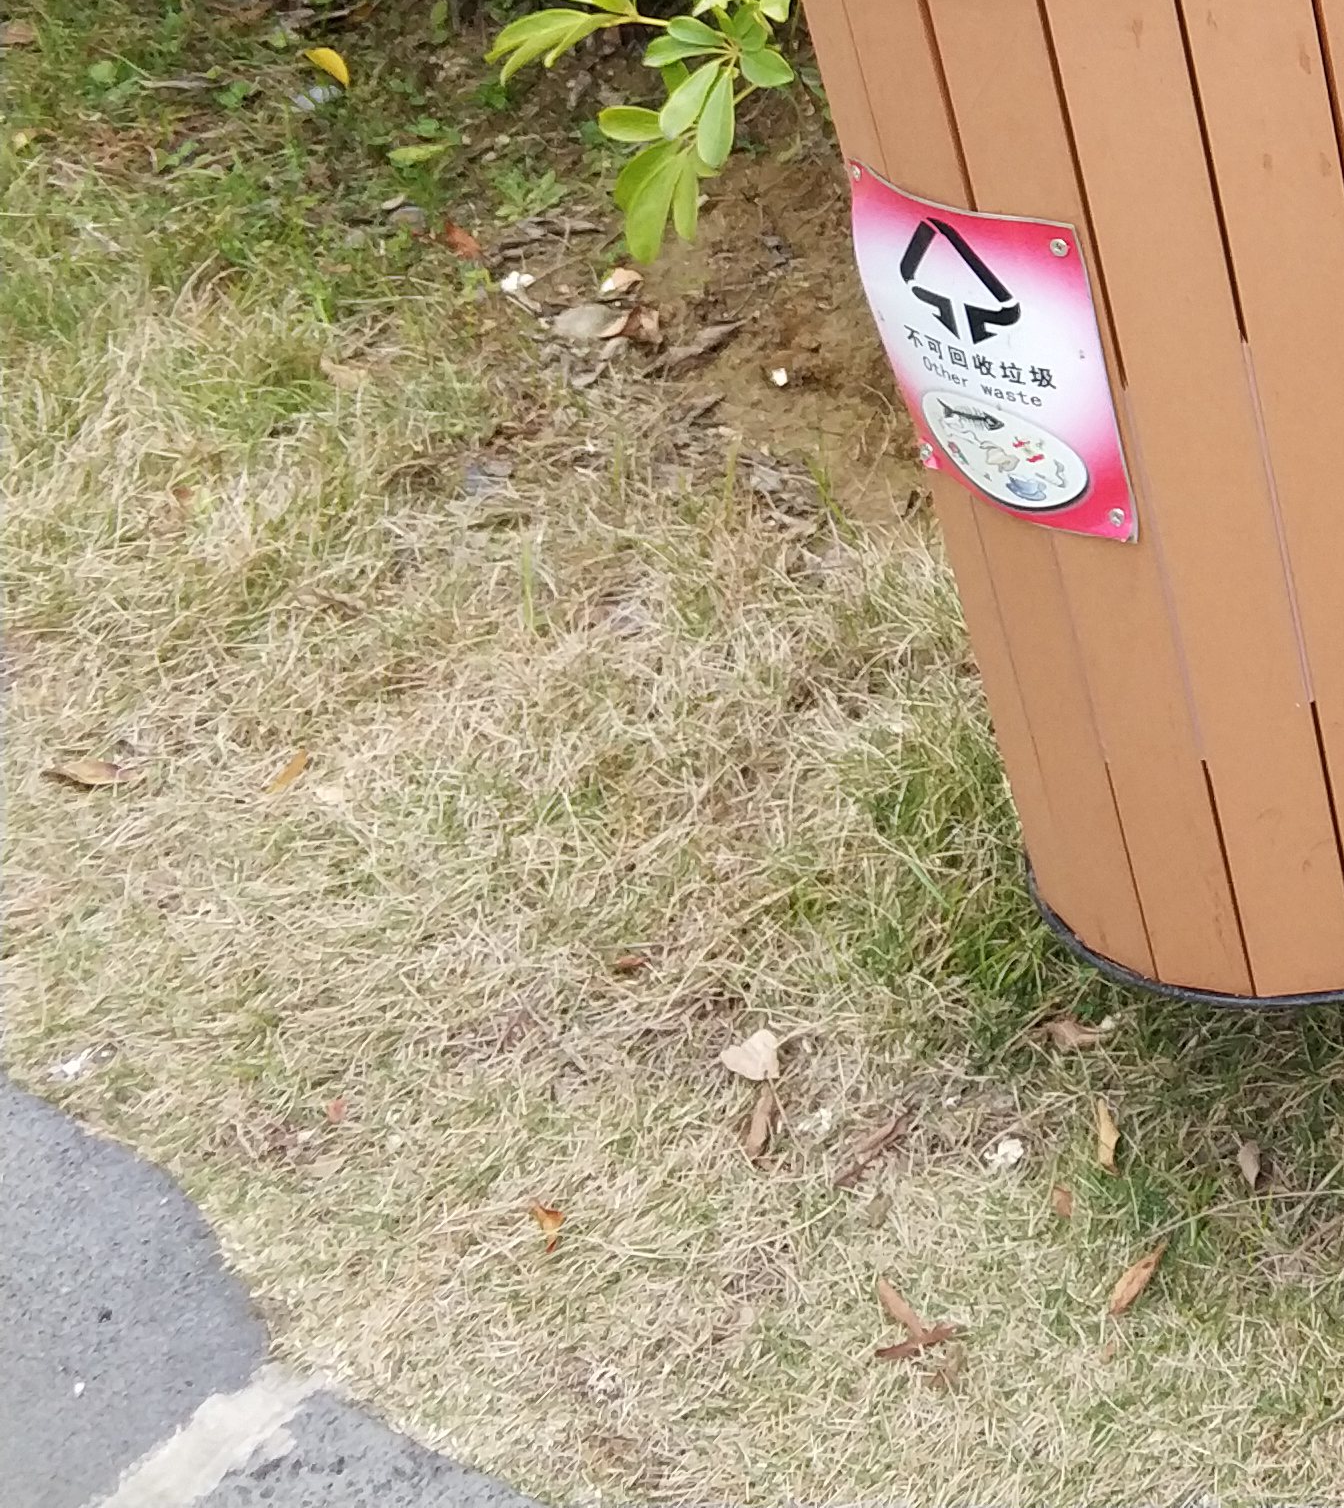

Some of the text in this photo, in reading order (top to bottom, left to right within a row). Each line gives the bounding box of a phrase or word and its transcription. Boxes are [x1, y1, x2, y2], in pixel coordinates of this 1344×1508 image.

[904, 325, 1057, 389] 不可回收垃圾
[922, 356, 1043, 407] Other waste
